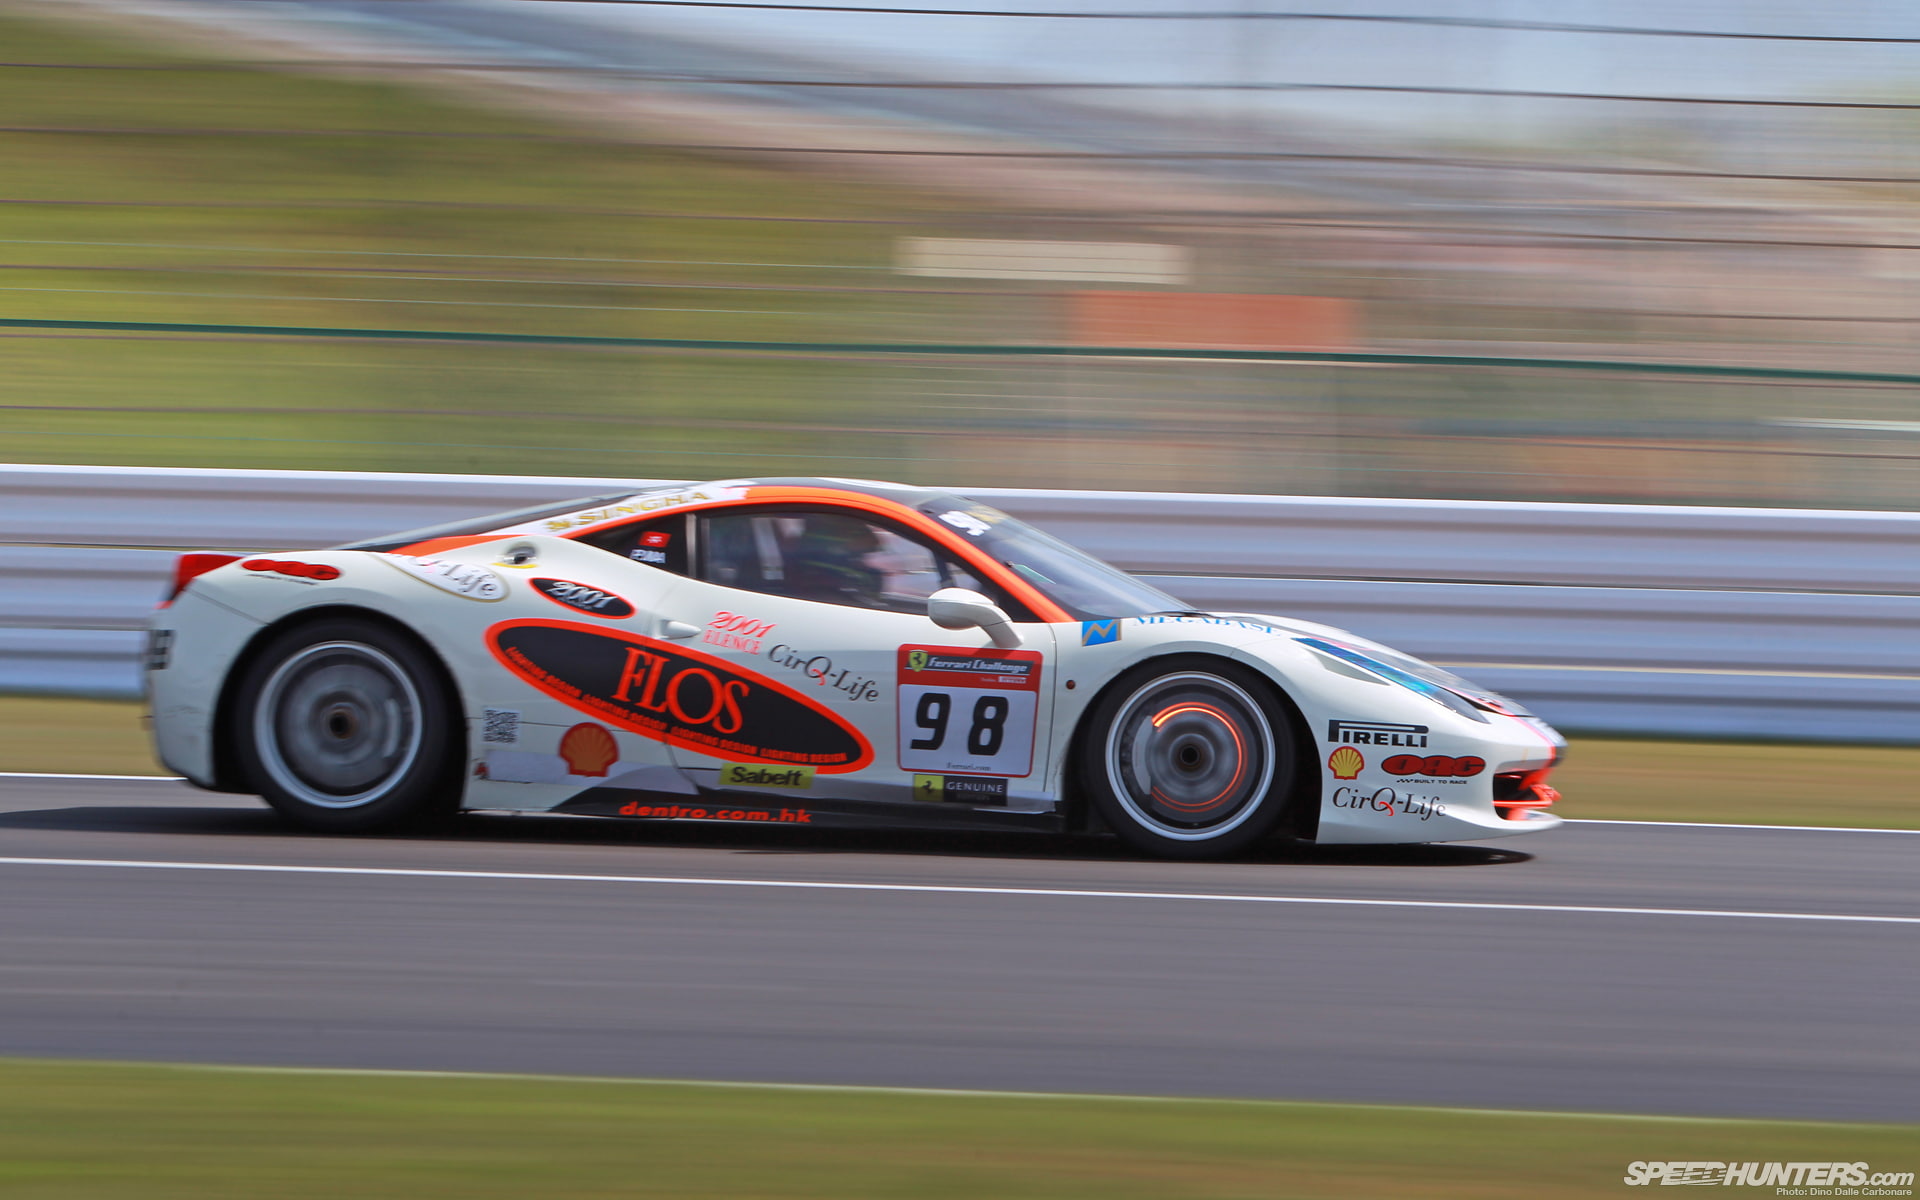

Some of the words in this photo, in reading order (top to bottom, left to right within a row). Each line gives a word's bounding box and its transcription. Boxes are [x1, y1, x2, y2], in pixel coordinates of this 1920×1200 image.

[576, 492, 711, 526] SINGHA
[545, 581, 618, 608] 2001
[707, 611, 777, 638] 2001
[702, 629, 764, 655] ELENCE
[768, 643, 880, 702] CirQ-Life
[928, 657, 972, 669] Ferrari
[972, 660, 1028, 674] Challenge
[611, 646, 750, 734] FLOS
[910, 692, 1009, 756] 98
[1328, 719, 1429, 748] PIRELLI
[720, 739, 758, 755] DESIGN
[810, 752, 848, 763] DESIGN
[730, 766, 803, 786] Sabelt
[946, 781, 1003, 793] GENUINE
[619, 801, 812, 823] dentro.com.hk
[1333, 786, 1446, 821] CirQ-Life
